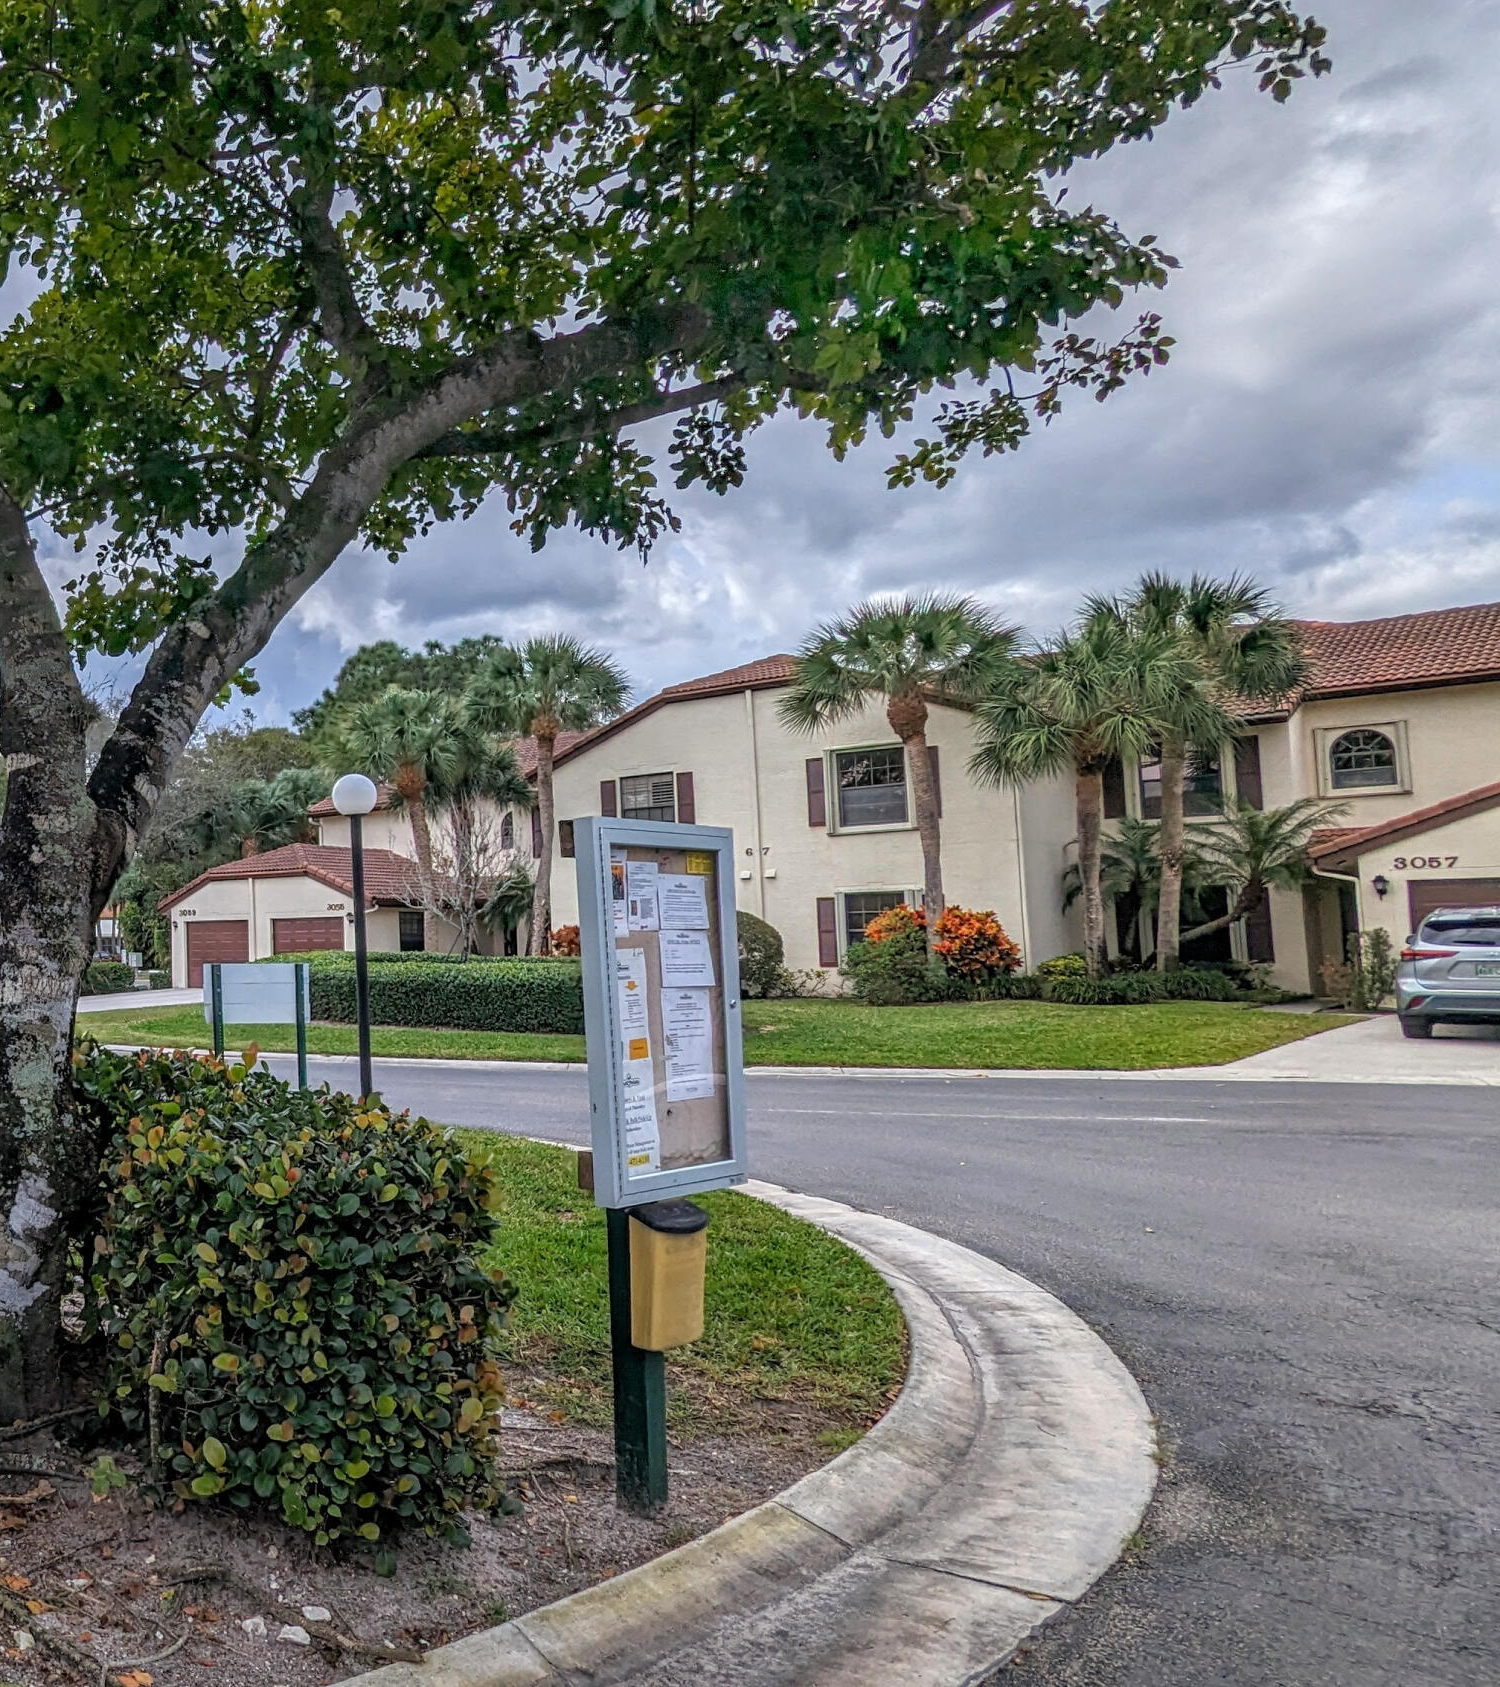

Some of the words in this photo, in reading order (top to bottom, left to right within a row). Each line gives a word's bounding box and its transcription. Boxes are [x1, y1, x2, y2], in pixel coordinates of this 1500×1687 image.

[746, 847, 753, 857] 6
[762, 847, 770, 856] 7
[1394, 856, 1458, 869] 3057
